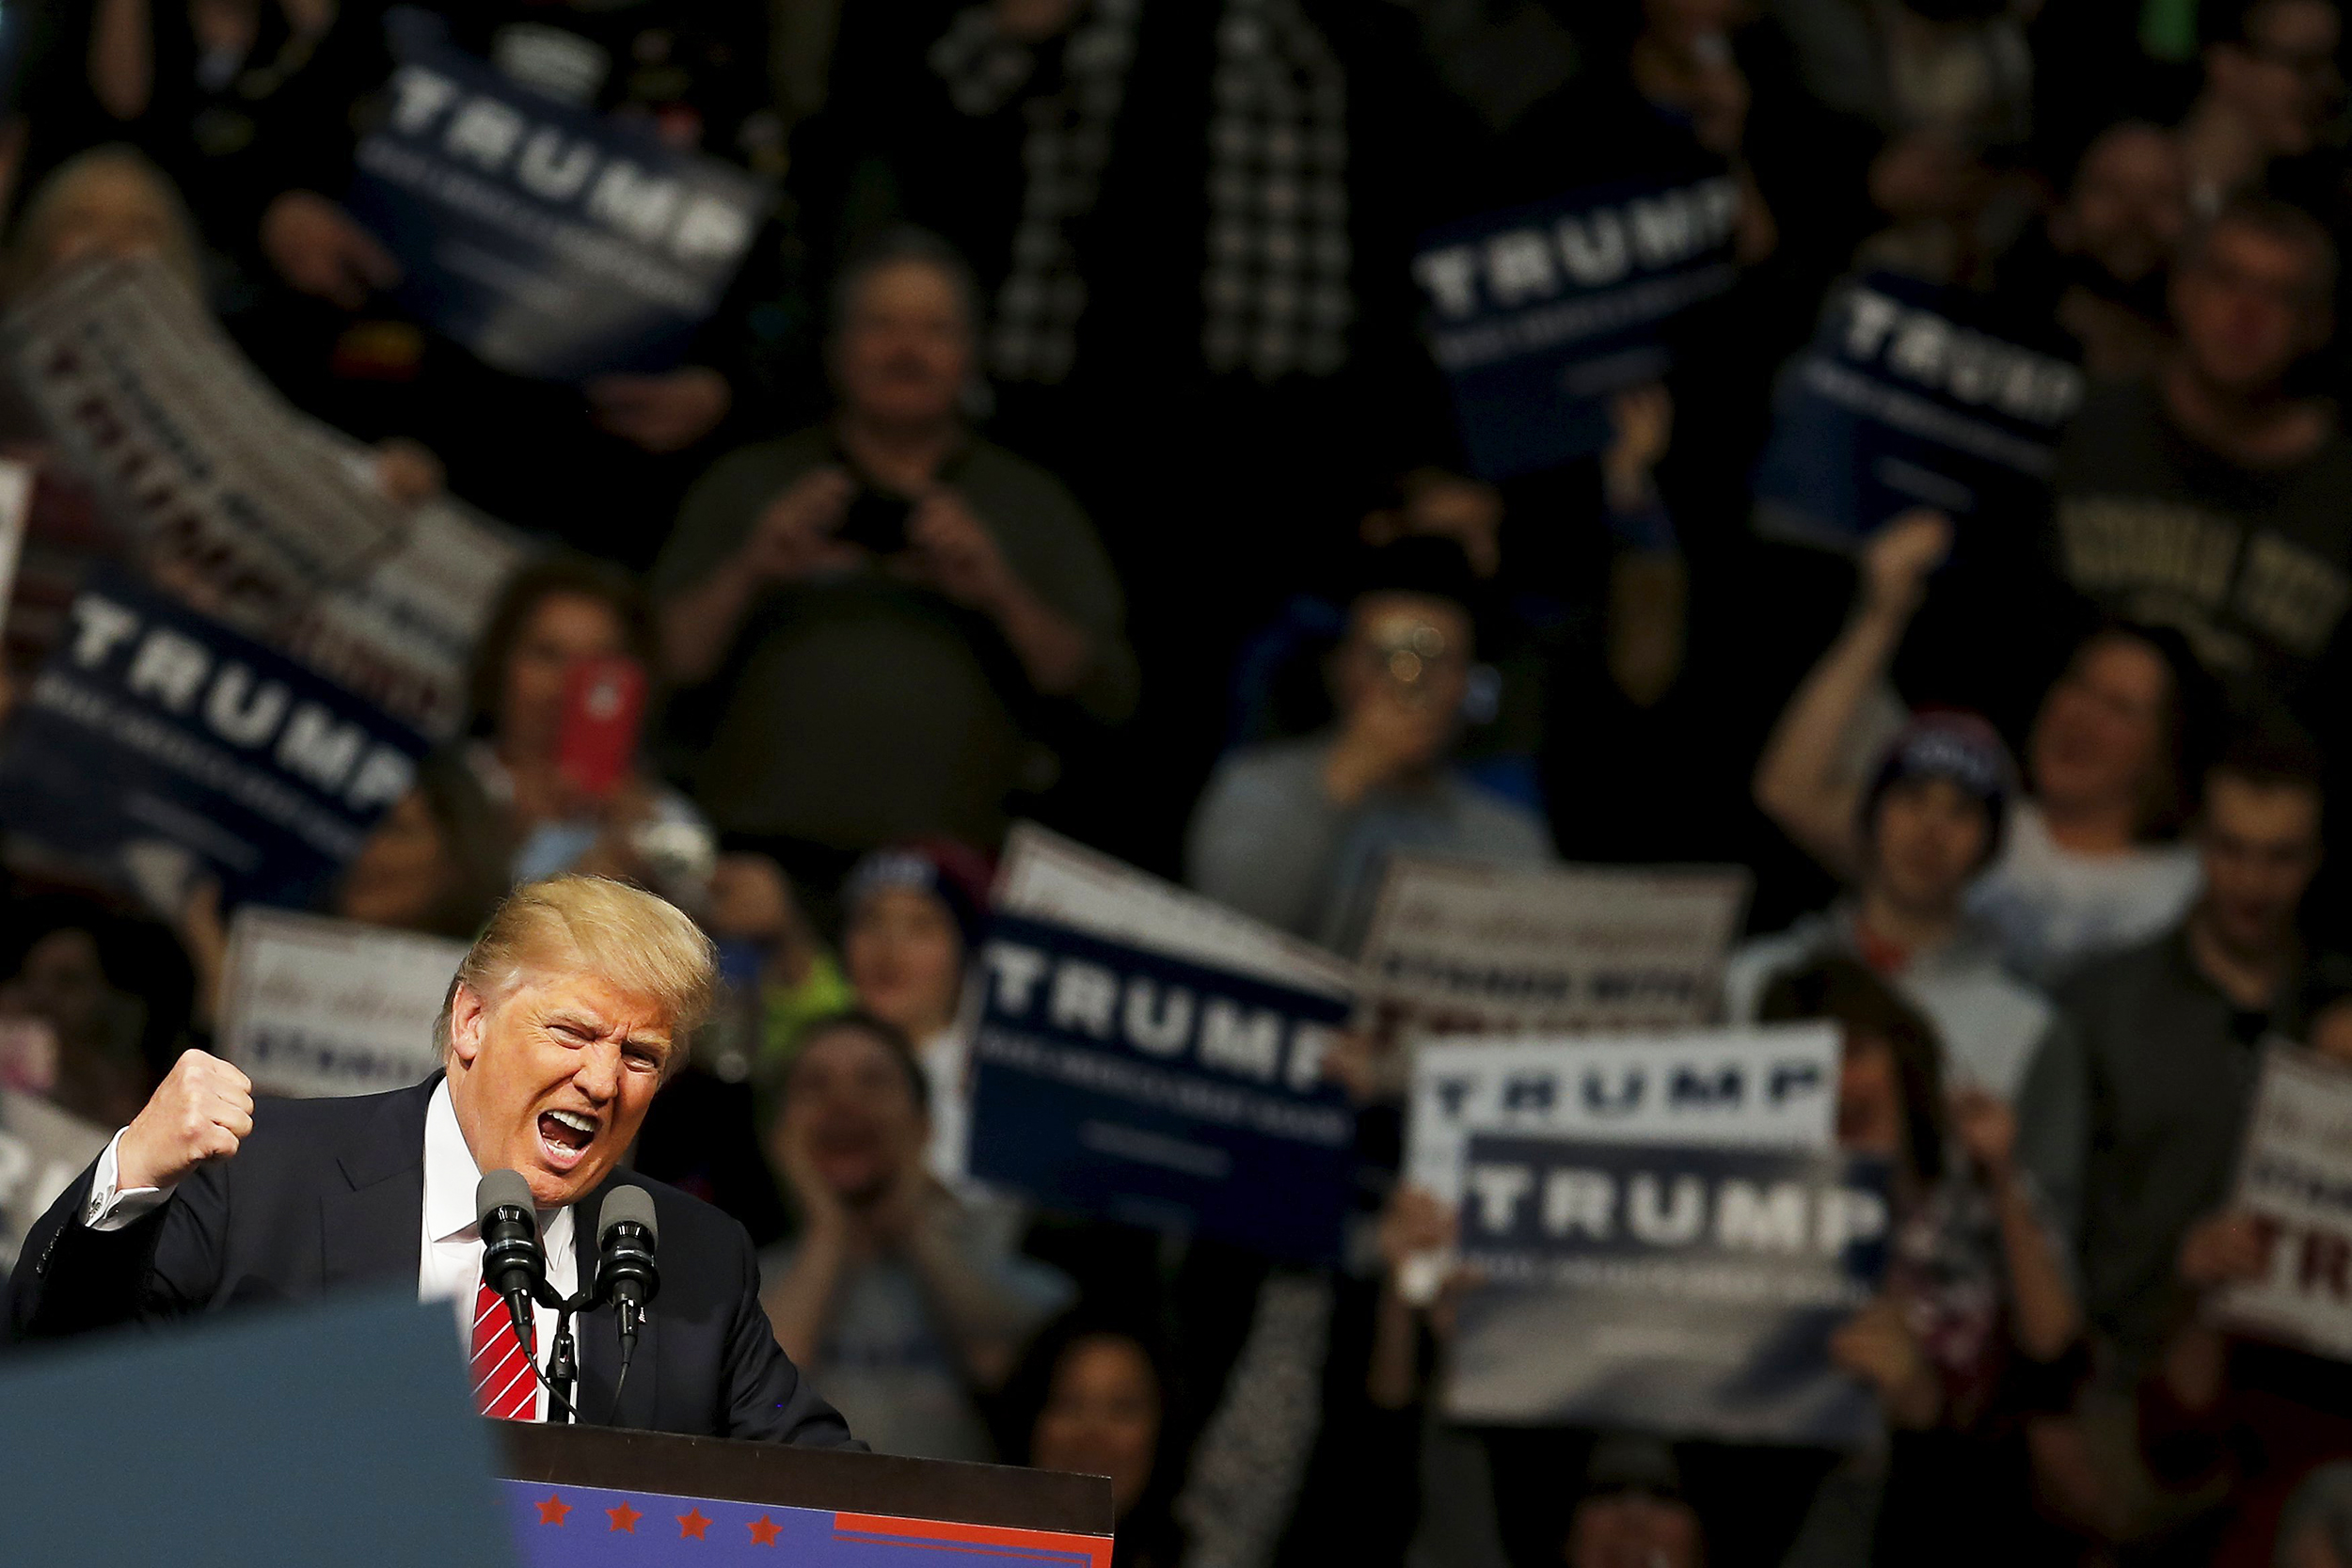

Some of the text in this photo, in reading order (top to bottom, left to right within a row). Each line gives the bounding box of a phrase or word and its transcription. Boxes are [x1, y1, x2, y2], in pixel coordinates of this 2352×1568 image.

[389, 66, 751, 260] TRUMP
[1411, 177, 1739, 321] TRUMP
[1837, 290, 2082, 425] TRUMP
[71, 591, 419, 813] TRUMP
[1435, 1060, 1827, 1125] TRUMP
[1470, 1164, 1891, 1258] TRUMP
